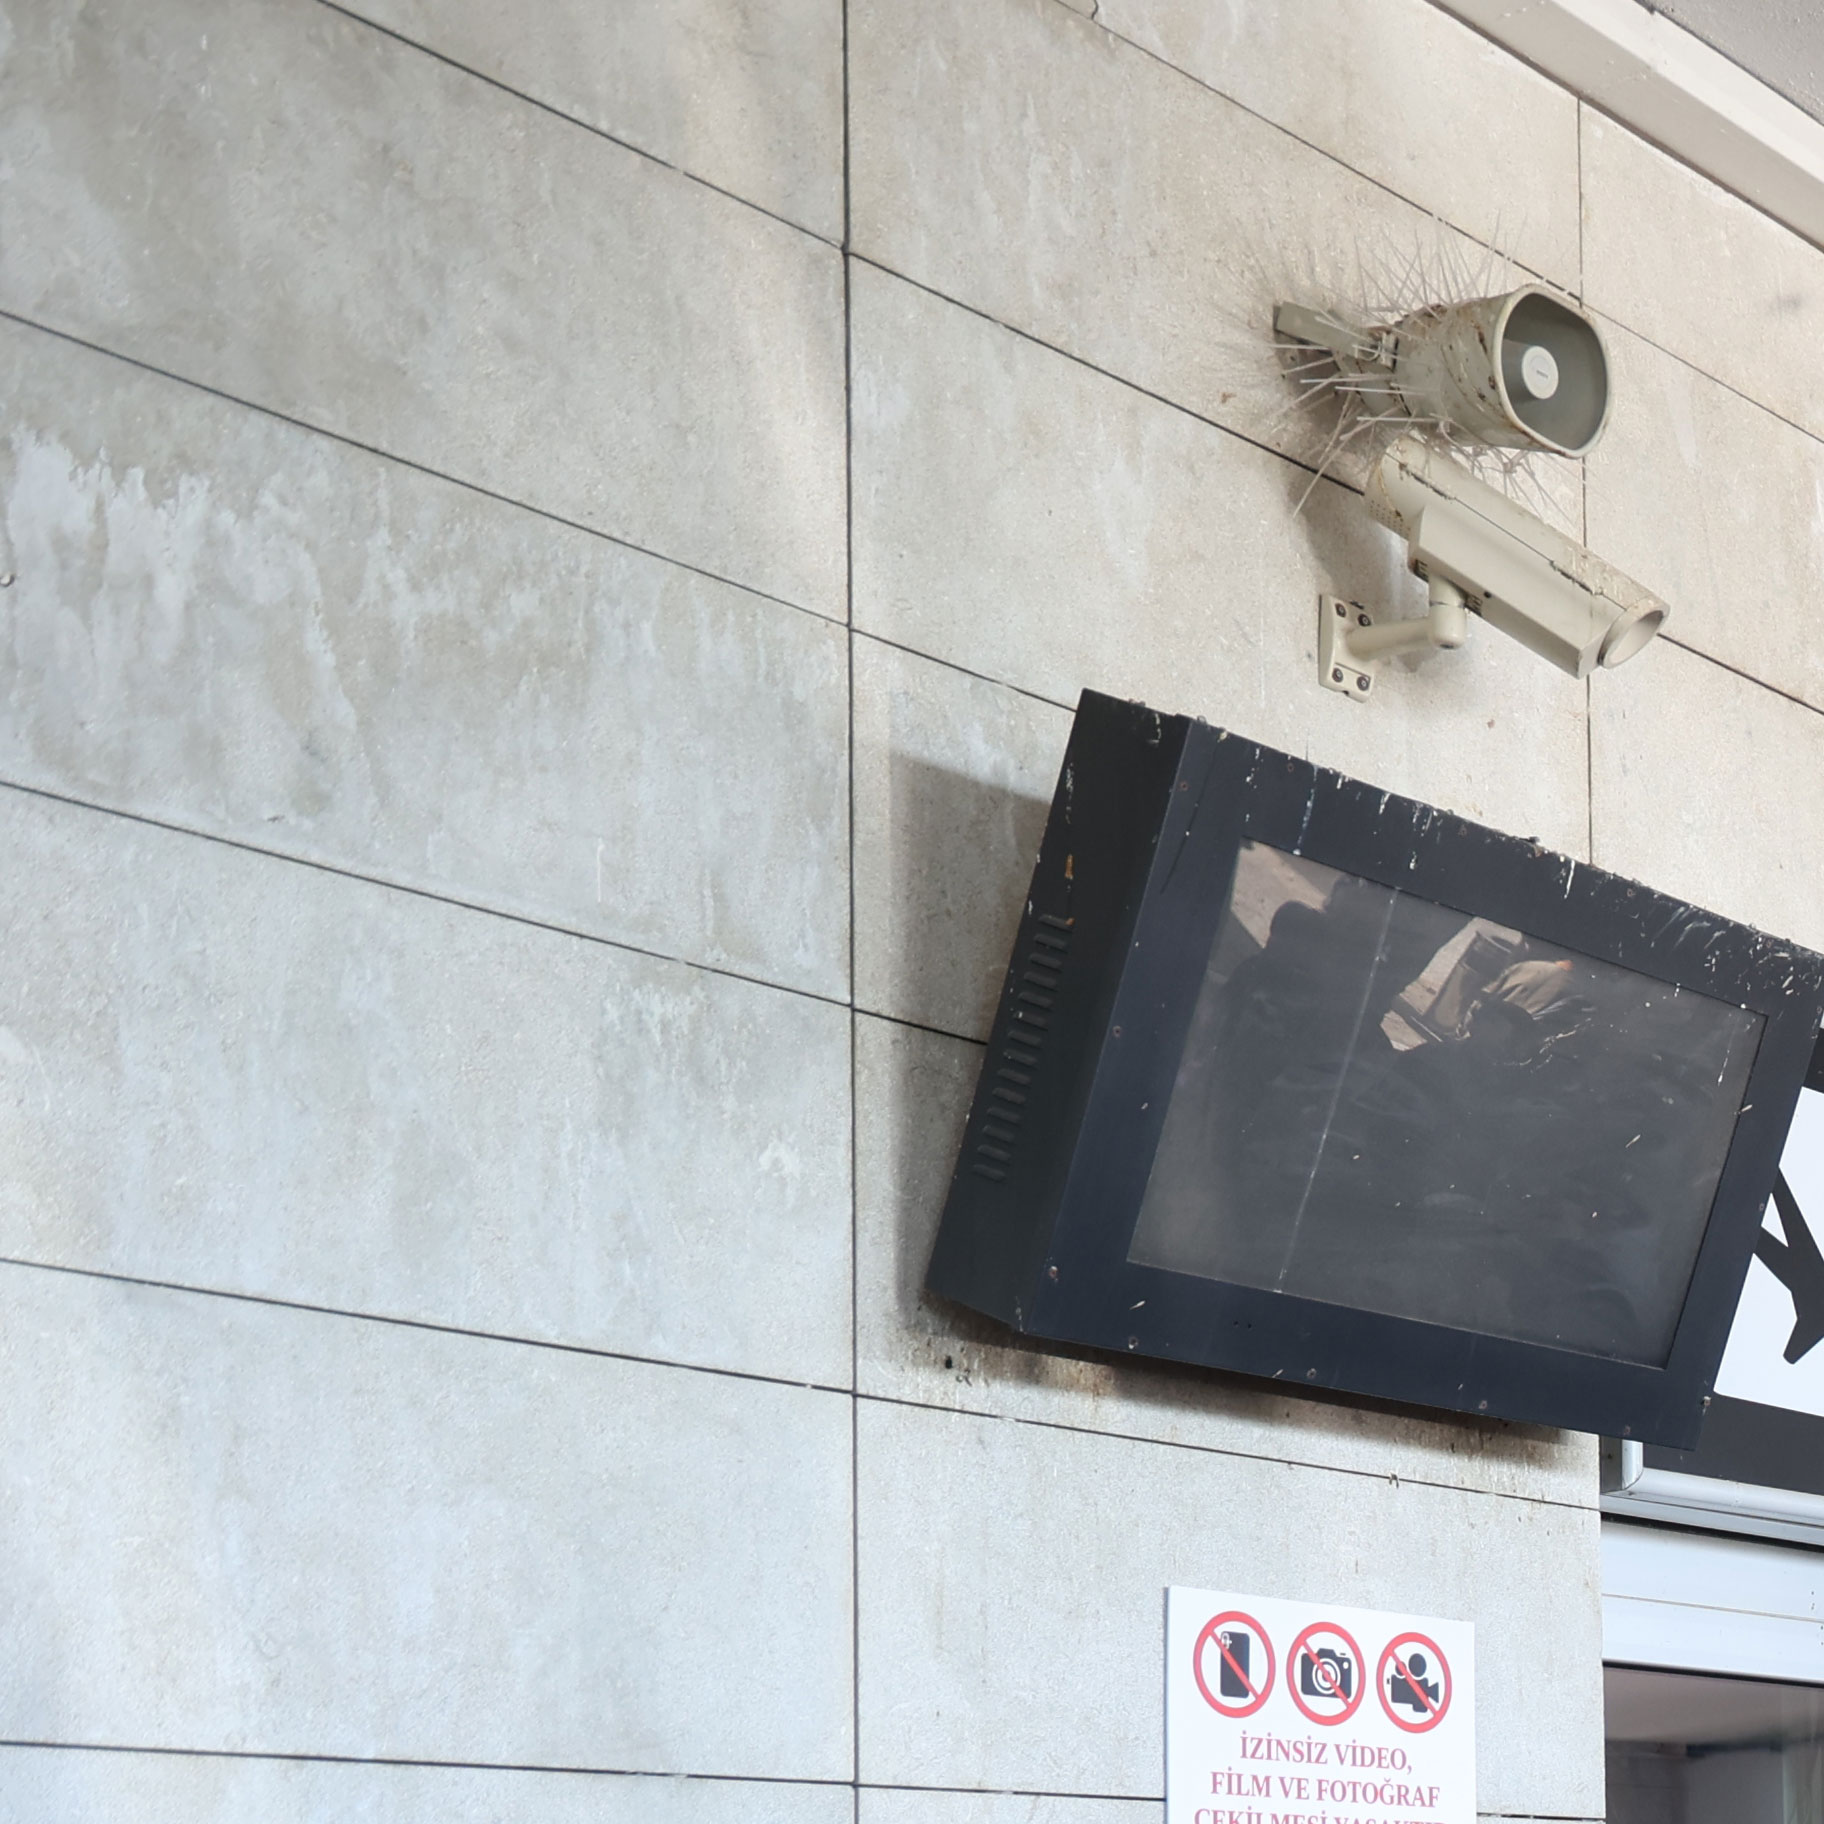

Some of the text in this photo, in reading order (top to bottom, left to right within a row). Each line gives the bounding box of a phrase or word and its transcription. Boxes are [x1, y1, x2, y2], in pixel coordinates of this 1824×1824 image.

[1240, 1730, 1412, 1774] İZİNSİZ VİDEO,
[1210, 1766, 1440, 1807] FİLM VE FOTOĞRAF
